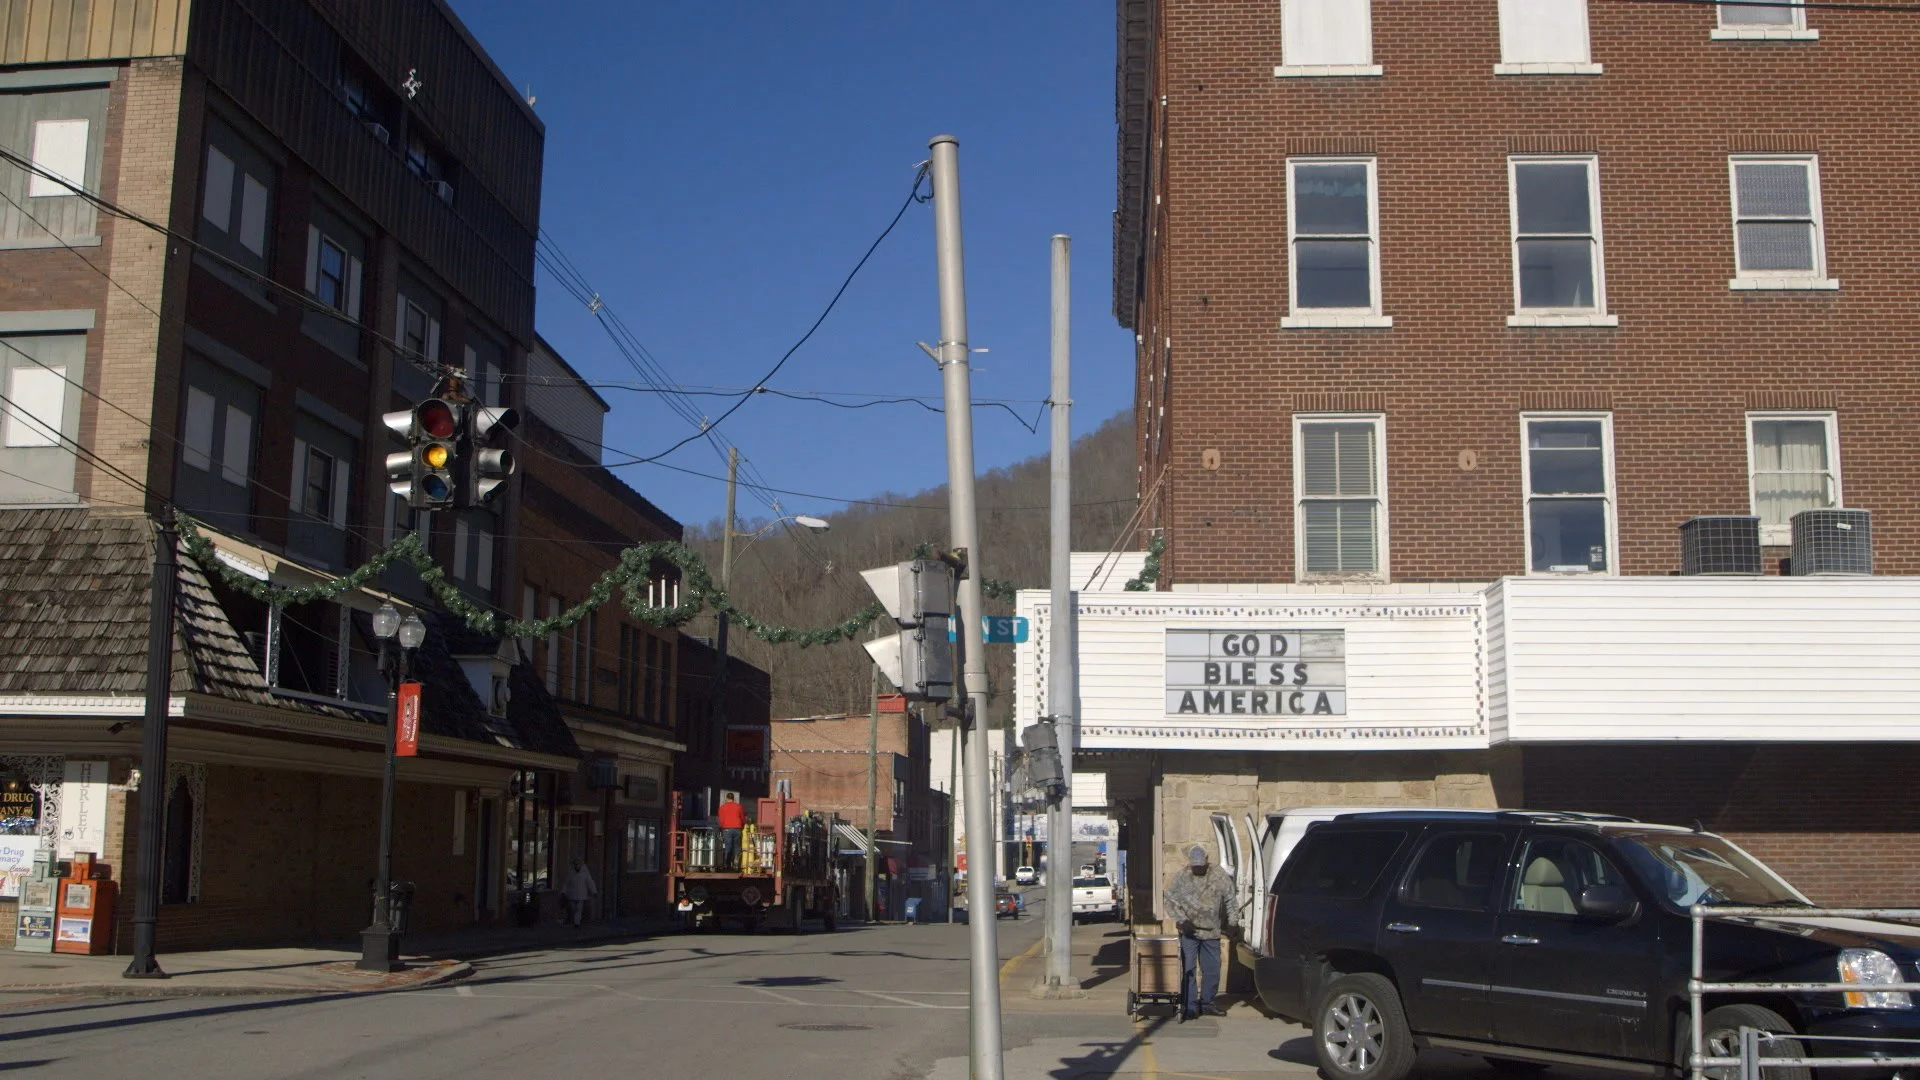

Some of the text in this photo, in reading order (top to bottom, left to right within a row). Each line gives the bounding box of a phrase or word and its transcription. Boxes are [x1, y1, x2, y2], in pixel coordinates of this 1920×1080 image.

[997, 619, 1021, 636] ST
[1222, 634, 1288, 657] GOD
[1204, 662, 1309, 685] BLESS
[1178, 690, 1333, 715] AMERICA
[3, 792, 35, 802] DRUG
[78, 763, 92, 839] HURLEY
[3, 847, 24, 857] Drug
